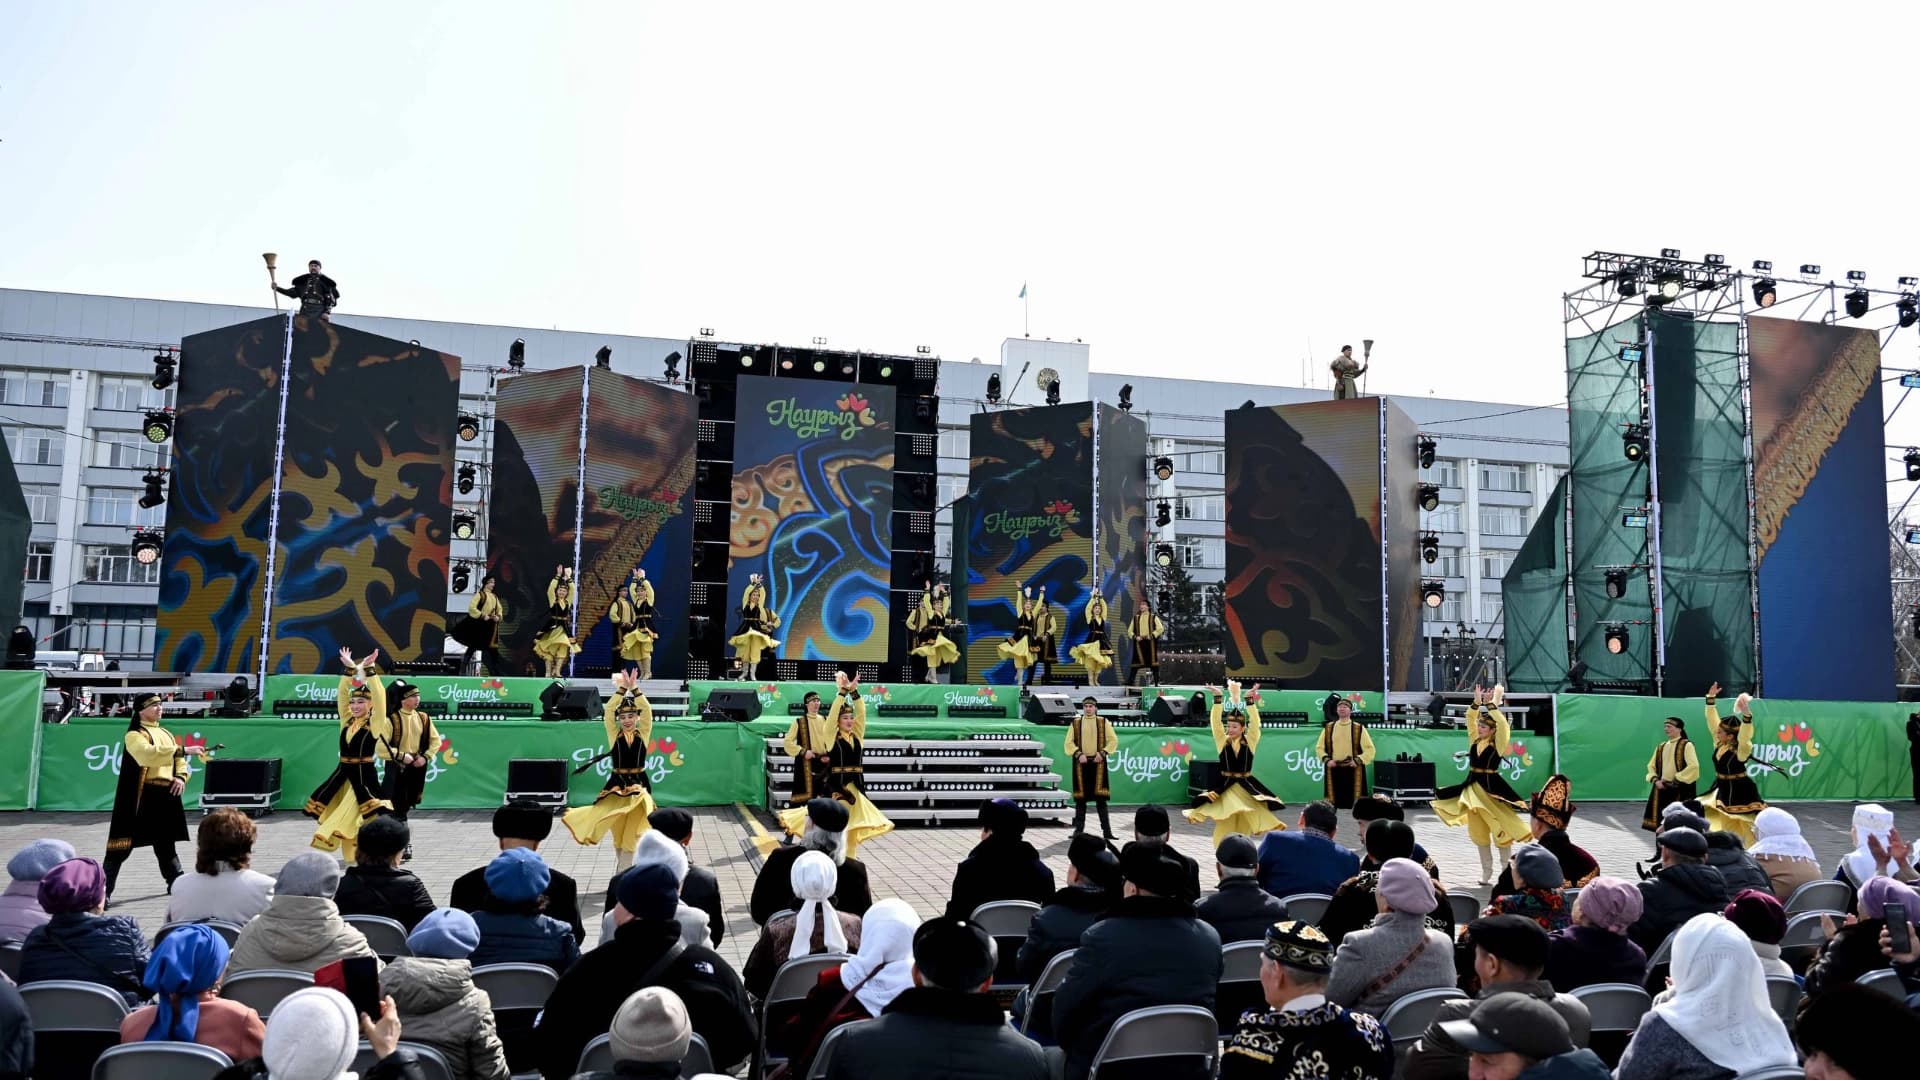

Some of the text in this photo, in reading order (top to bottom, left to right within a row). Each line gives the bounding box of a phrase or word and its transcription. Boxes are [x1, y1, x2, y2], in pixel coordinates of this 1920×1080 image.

[766, 397, 864, 440] Наурыз
[598, 485, 674, 525] Наурыз
[983, 509, 1069, 540] Наурыз
[295, 682, 352, 702] Наур
[438, 683, 502, 703] Наурыз
[572, 745, 674, 783] Наыз
[1106, 747, 1189, 782] Наурыз
[1284, 747, 1325, 781] Нау
[1744, 743, 1811, 777] урыз
